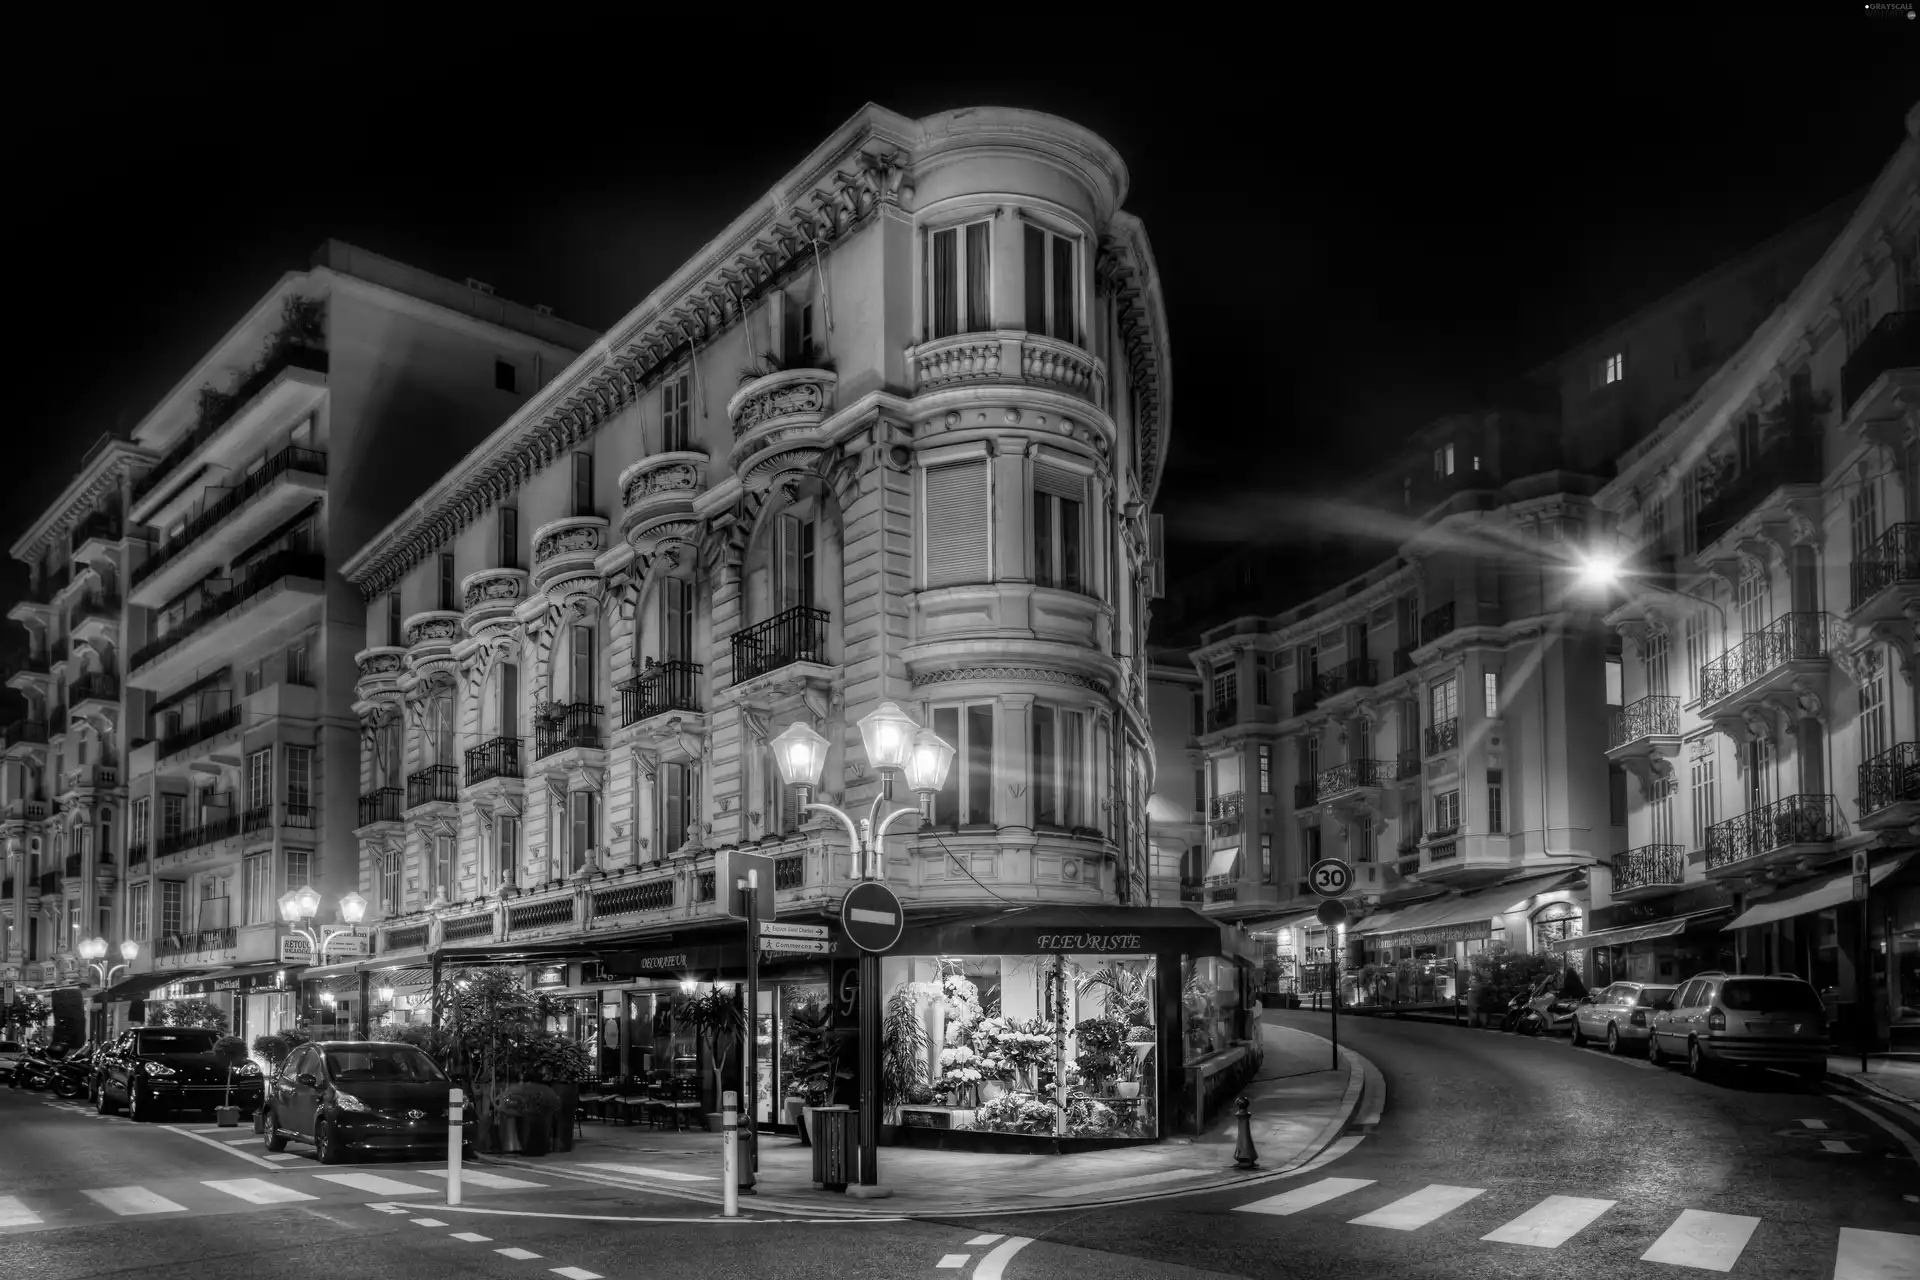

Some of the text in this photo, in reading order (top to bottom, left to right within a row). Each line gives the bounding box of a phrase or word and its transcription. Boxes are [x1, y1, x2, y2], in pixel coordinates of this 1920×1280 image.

[1318, 869, 1345, 887] 30
[775, 941, 813, 949] Commerces
[1037, 932, 1141, 951] FLEURISTE
